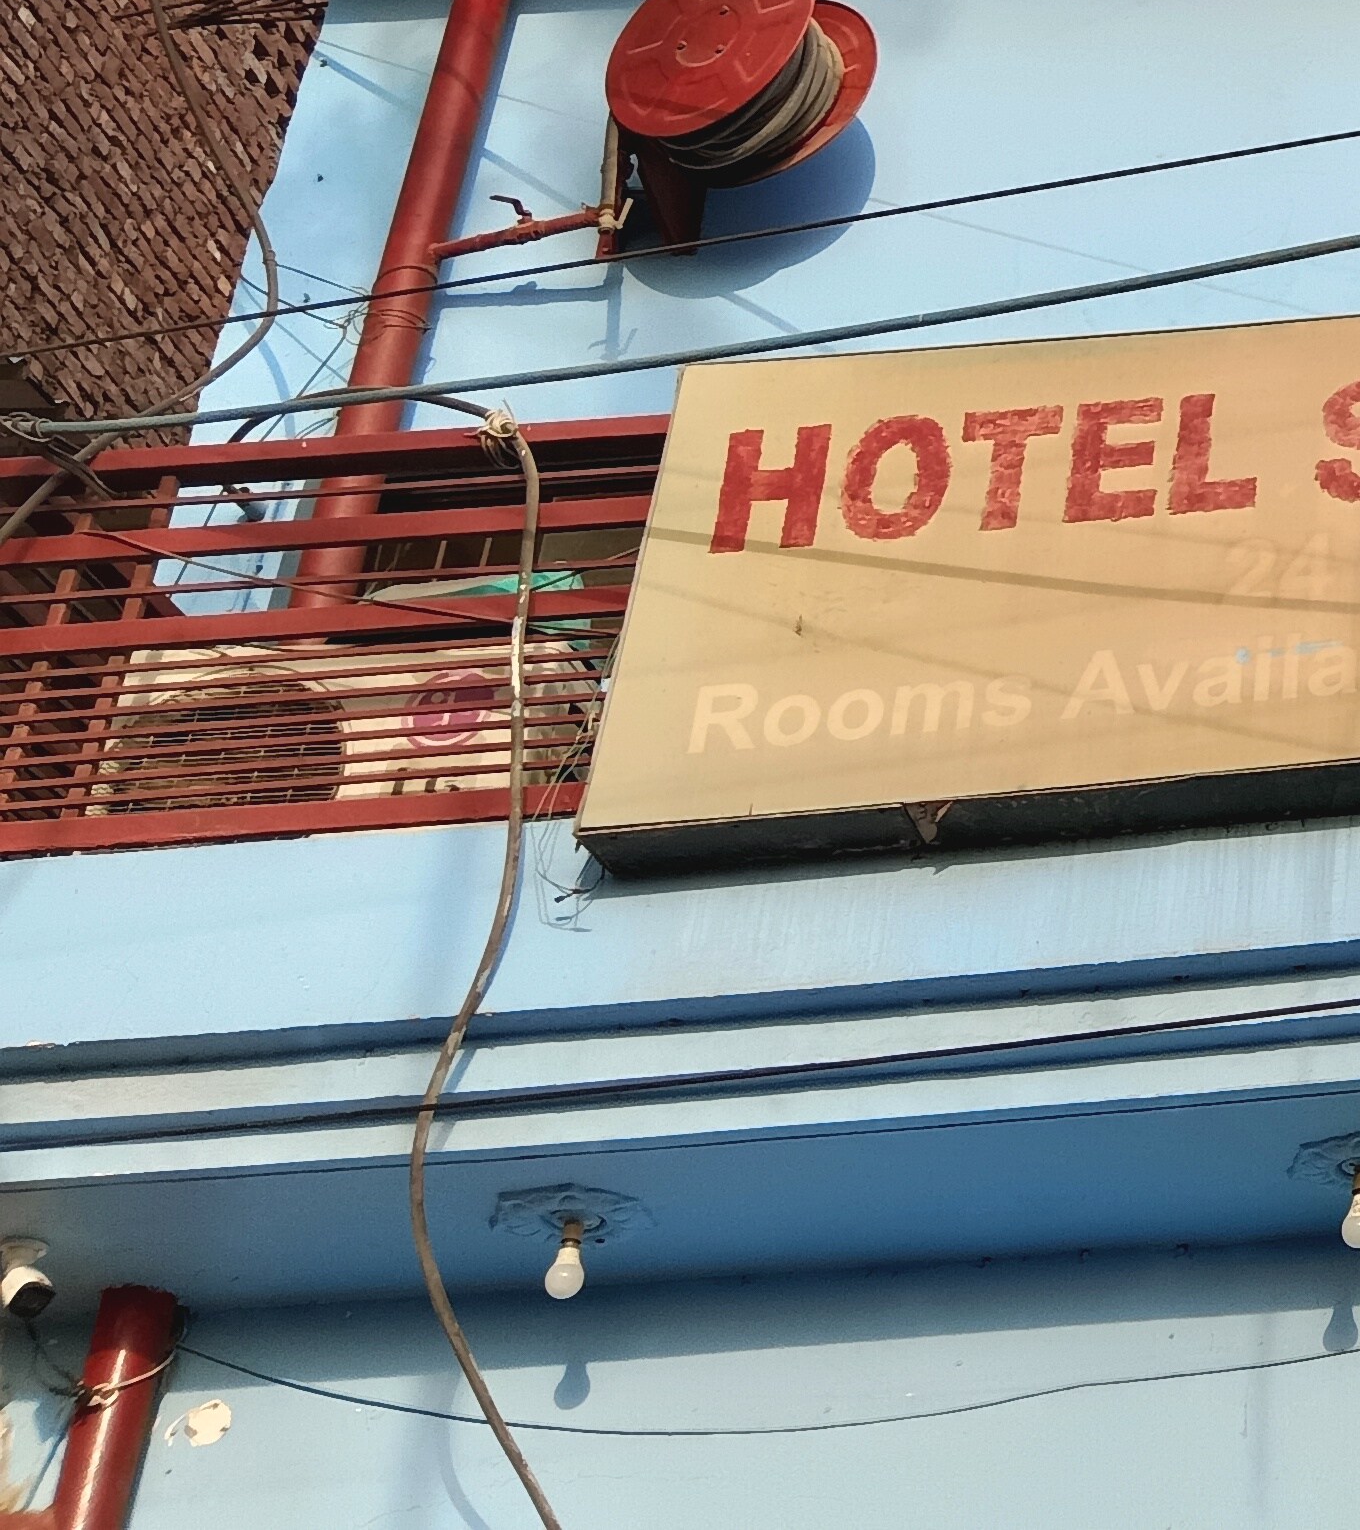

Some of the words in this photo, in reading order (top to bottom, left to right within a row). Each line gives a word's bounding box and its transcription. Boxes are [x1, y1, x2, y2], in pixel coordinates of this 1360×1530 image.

[708, 391, 1258, 555] HOTEL
[1228, 531, 1334, 601] 24
[688, 672, 1031, 755] Rooms
